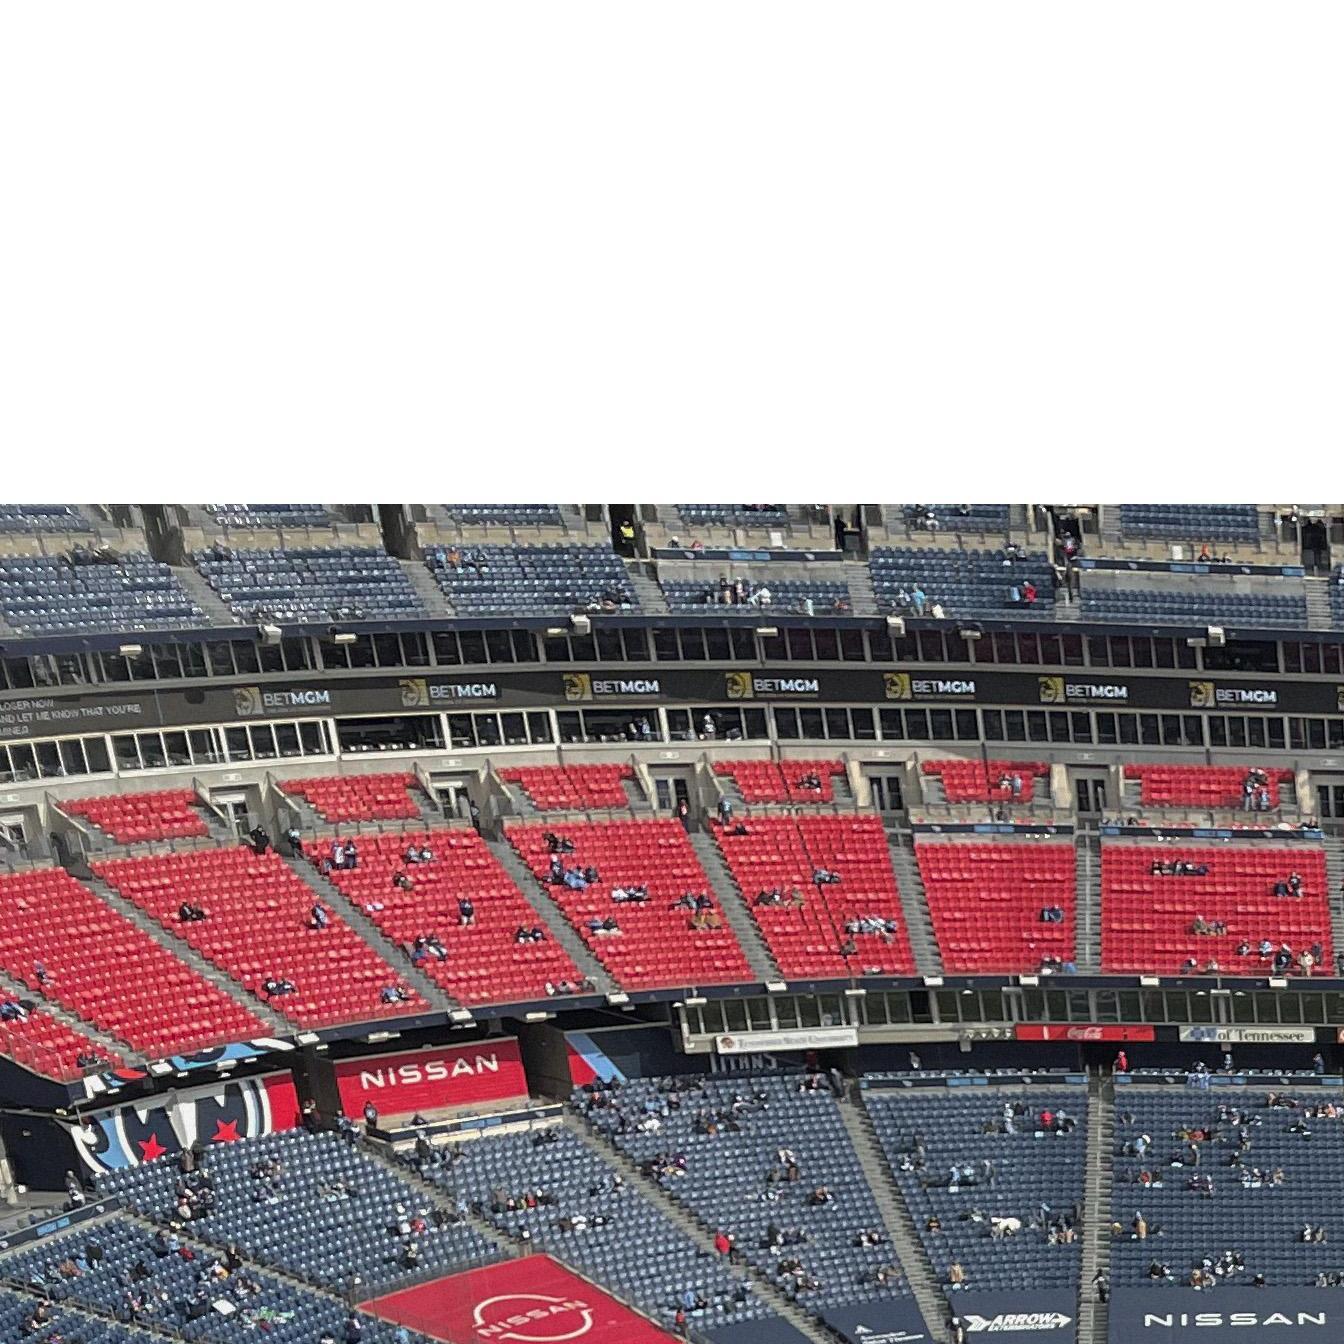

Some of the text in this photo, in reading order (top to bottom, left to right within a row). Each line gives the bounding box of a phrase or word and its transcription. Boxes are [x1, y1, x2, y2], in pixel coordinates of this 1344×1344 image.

[429, 683, 496, 699] BETMGM
[593, 680, 659, 693] BETMGM
[754, 678, 818, 692] BETMGM
[912, 680, 975, 694] BETMGM
[1066, 684, 1128, 699] BETMGM
[263, 690, 330, 707] BETMGM
[1215, 689, 1277, 703] BETMGM
[80, 707, 103, 717] THAT
[1218, 1028, 1231, 1041] of
[1238, 1029, 1305, 1041] Tennessee
[360, 1054, 499, 1090] NISSAN
[477, 1299, 589, 1337] NISSAN
[993, 1312, 1054, 1326] ARROW
[1144, 1312, 1326, 1327] NISSAN
